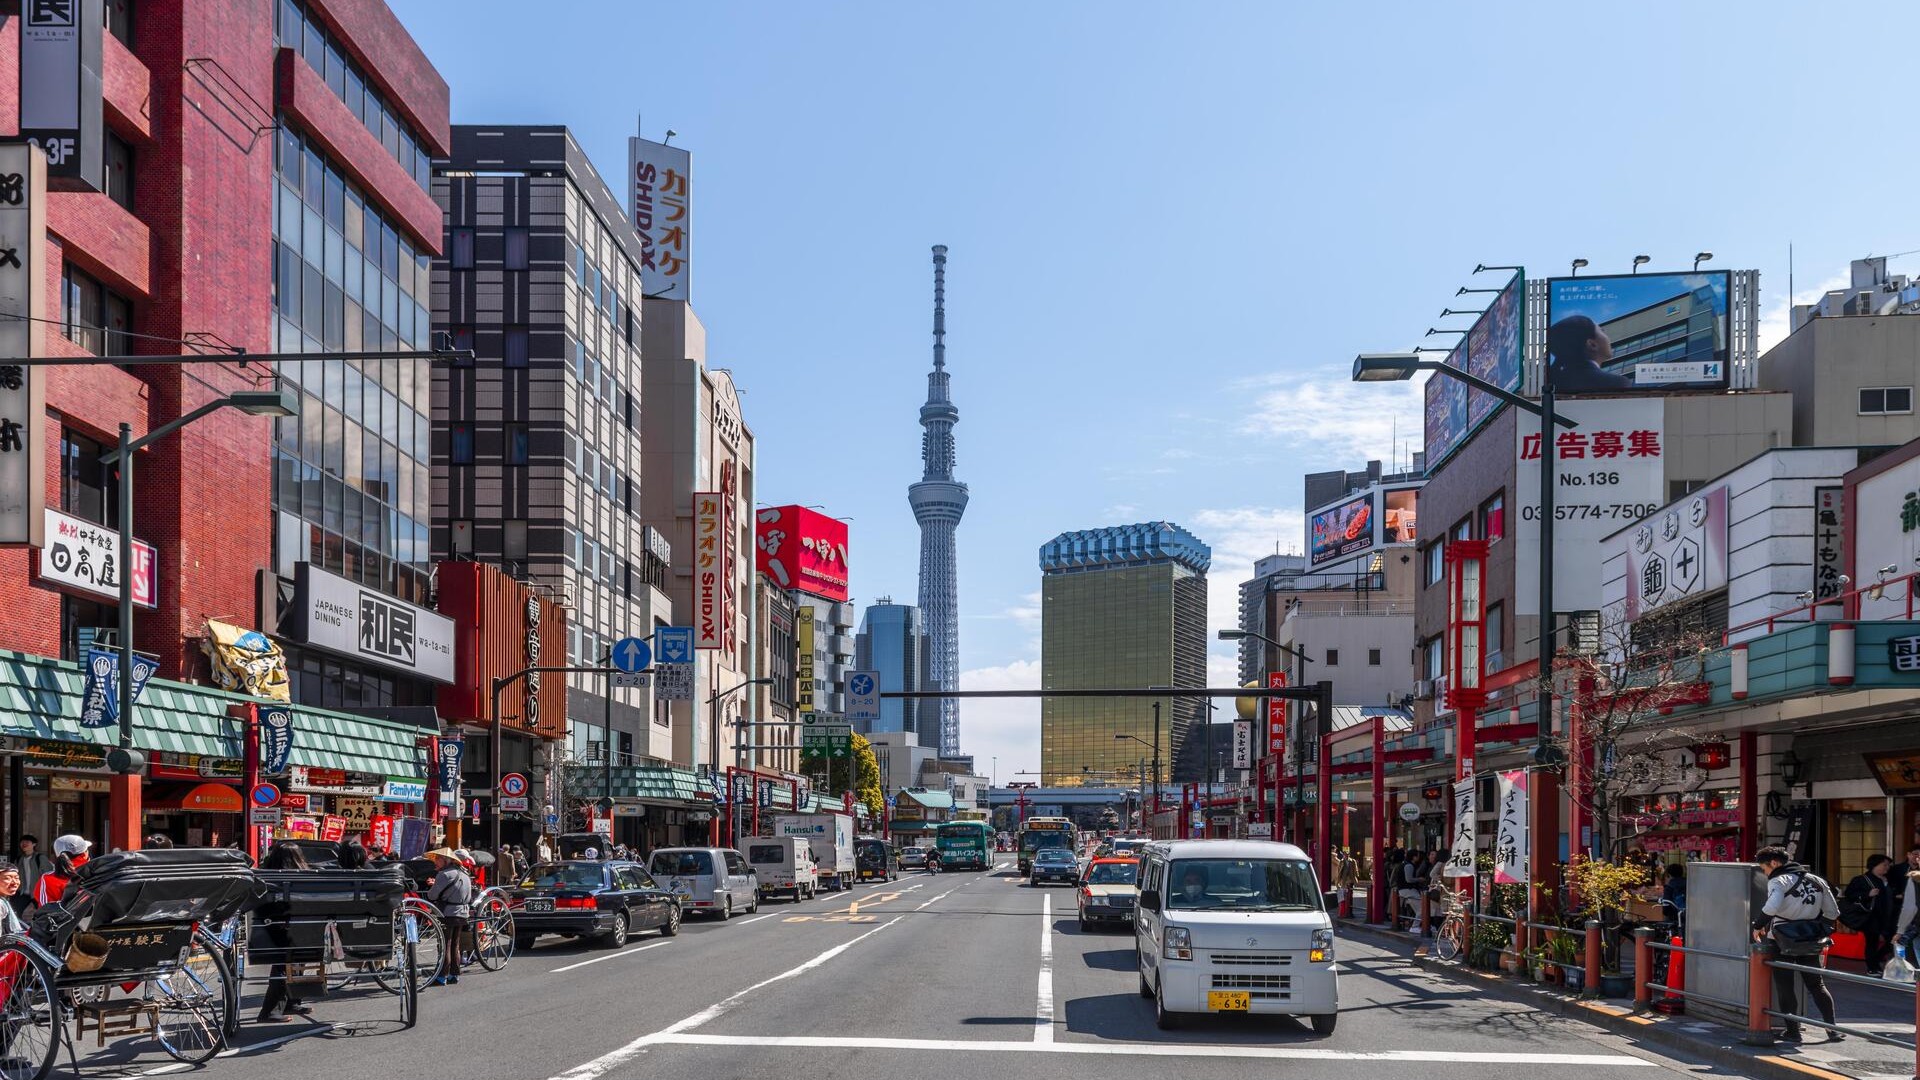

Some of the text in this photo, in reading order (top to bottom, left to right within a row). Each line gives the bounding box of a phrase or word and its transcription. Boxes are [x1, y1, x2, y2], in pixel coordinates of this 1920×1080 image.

[636, 161, 656, 272] SHIDAX
[659, 168, 687, 276] カラオケ
[1520, 430, 1661, 460] 広告募集
[1560, 472, 1620, 487] No.136
[1522, 503, 1657, 521] 035774-7506
[699, 499, 717, 568] カラオケ
[802, 537, 848, 568] つぼ八
[50, 541, 120, 588] 日高屋
[315, 599, 353, 619] JAPANESE
[315, 611, 341, 627] DINING
[701, 571, 715, 641] SHIDAX
[361, 598, 413, 662] 和民
[418, 636, 451, 655] wa-ta-mi
[800, 654, 813, 704] 神谷バー
[389, 783, 425, 800] FamilyMart
[784, 825, 814, 834] Hansui
[1447, 795, 1474, 868] 豆大福
[1496, 789, 1519, 867] さくら餅
